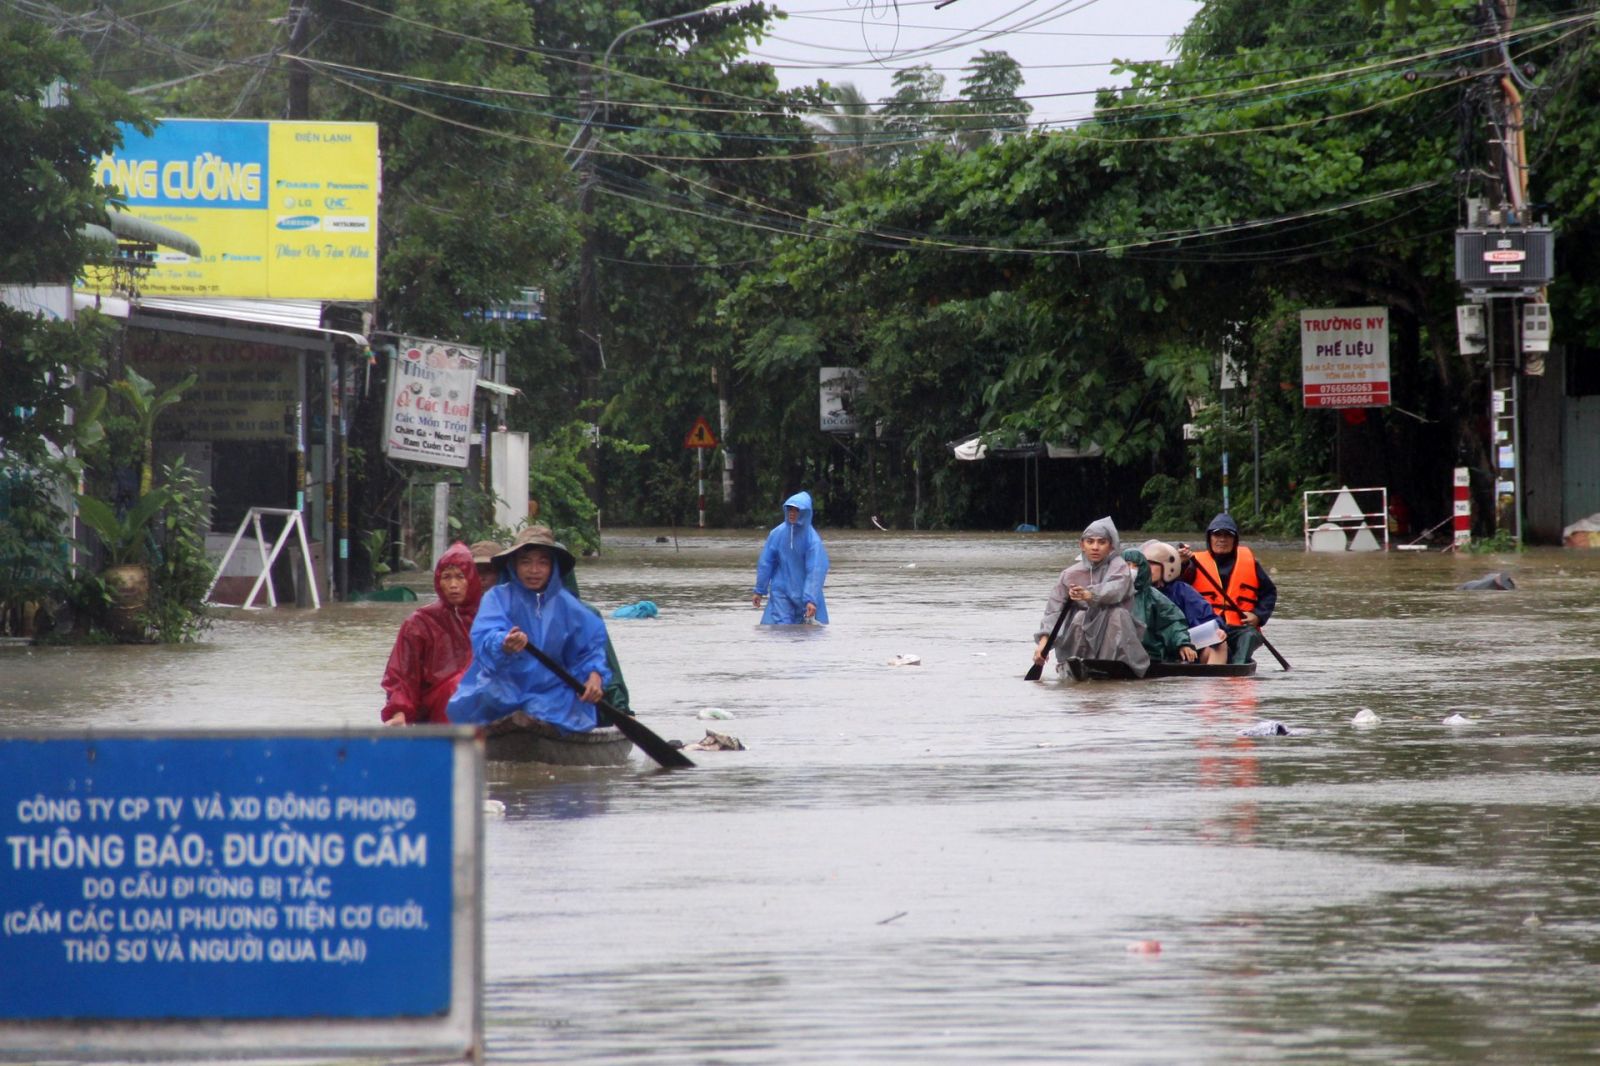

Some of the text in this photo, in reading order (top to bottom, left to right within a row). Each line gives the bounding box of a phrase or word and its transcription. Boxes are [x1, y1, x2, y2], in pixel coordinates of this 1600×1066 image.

[162, 152, 261, 201] CƯỜNG
[1304, 315, 1384, 332] TRƯỜNG NY
[1316, 340, 1374, 357] PHẾ LIỆU
[1320, 383, 1373, 393] 0766506063
[17, 793, 82, 823] CÔNG
[87, 797, 115, 821] TY
[118, 798, 150, 821] CP
[155, 797, 183, 820] TV
[192, 791, 224, 820] VÀ
[229, 797, 261, 820] XD
[335, 797, 416, 821] PHONG
[6, 821, 428, 870] THÔNG BÁO: ĐƯỜNG CẤM
[82, 877, 115, 899] DO
[259, 877, 282, 903] BỊ
[67, 903, 114, 932] CÁC
[119, 907, 173, 935] LOẠI
[178, 906, 278, 931] PHƯƠNG
[283, 899, 336, 934] TIỆN
[340, 903, 373, 929] CƠ
[116, 937, 149, 963] SƠ
[152, 932, 184, 962] VÀ
[189, 932, 263, 962] NGƯỜI
[267, 938, 317, 962] QUA
